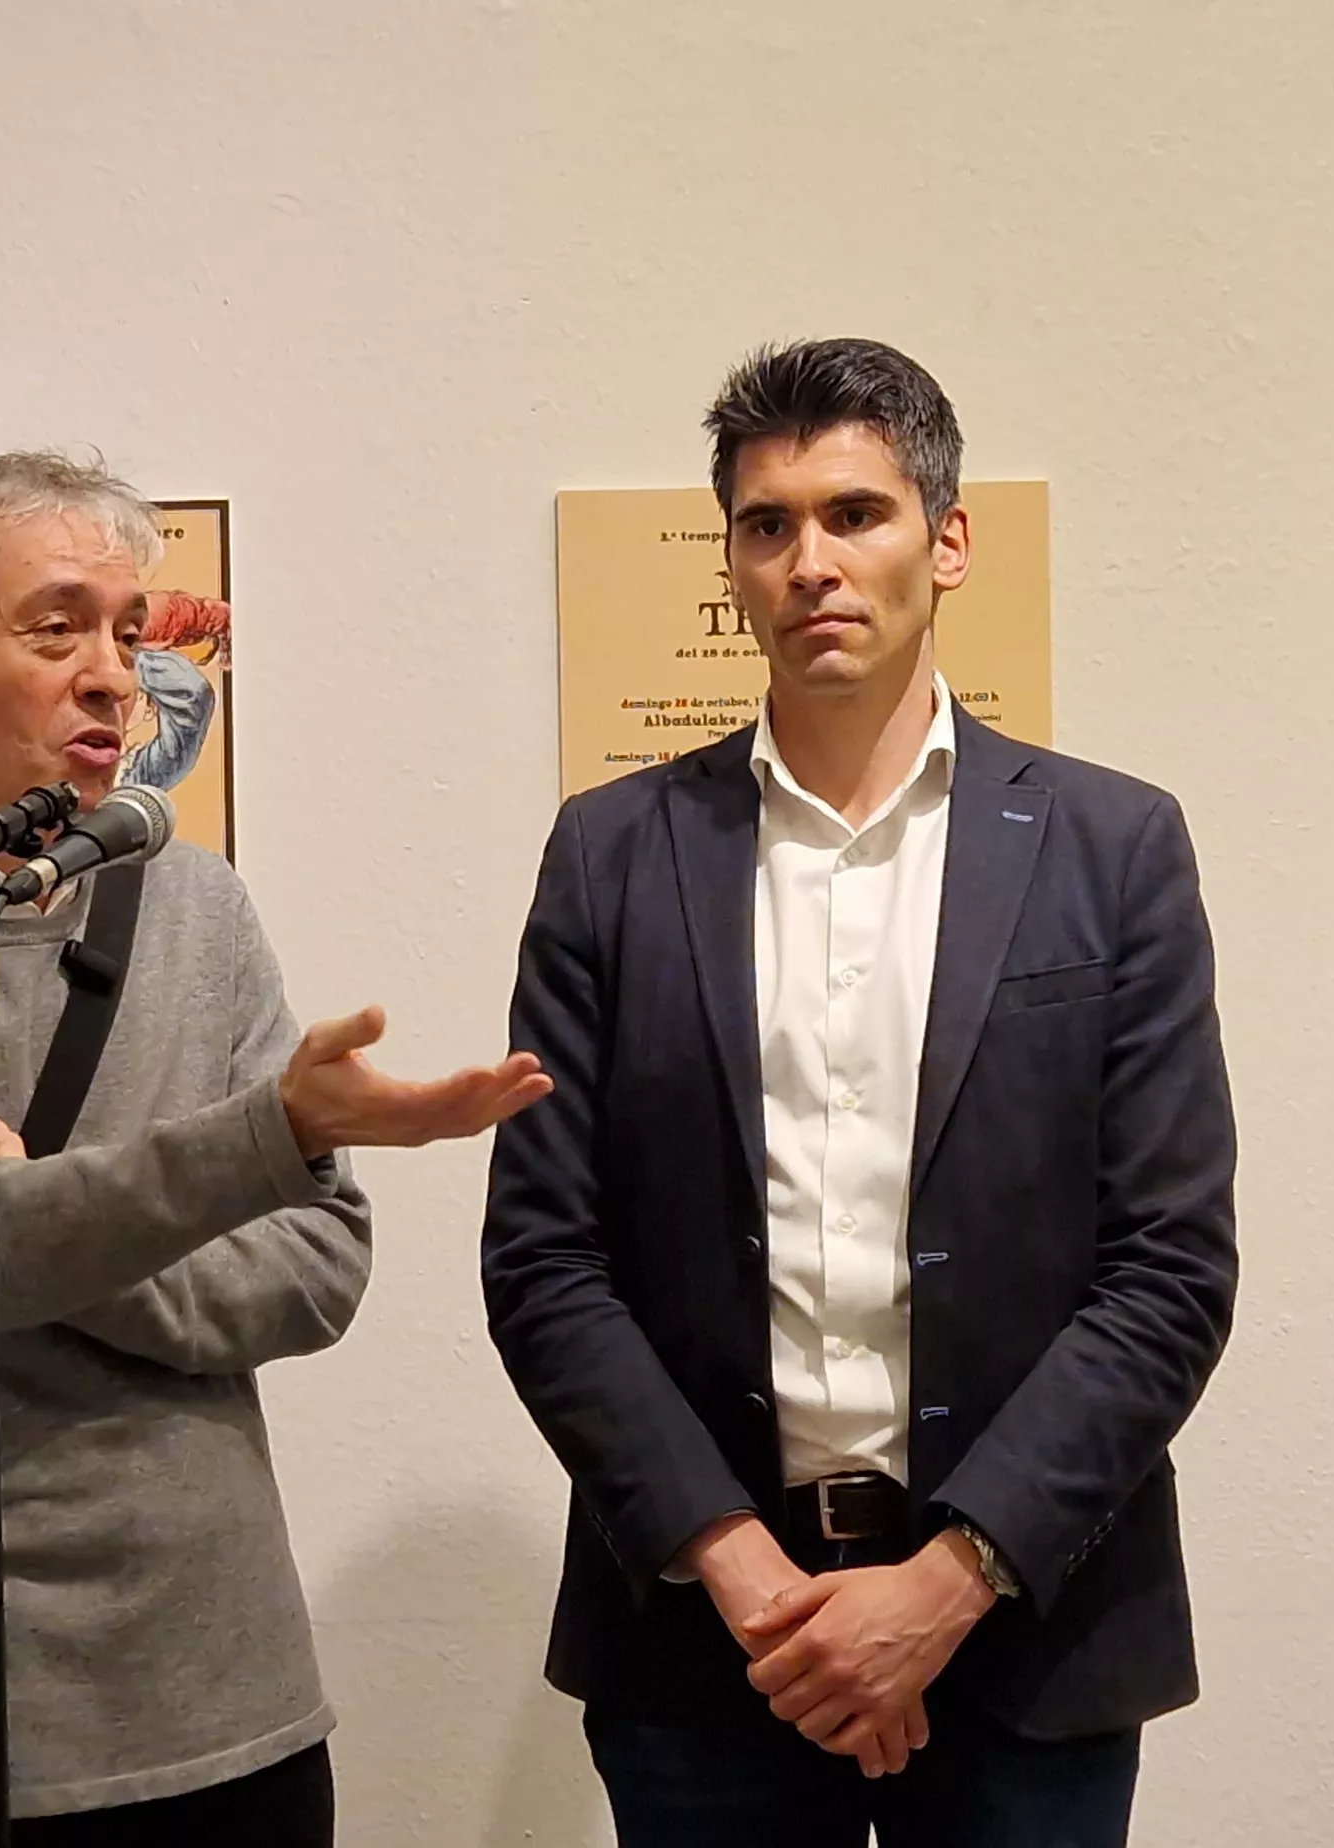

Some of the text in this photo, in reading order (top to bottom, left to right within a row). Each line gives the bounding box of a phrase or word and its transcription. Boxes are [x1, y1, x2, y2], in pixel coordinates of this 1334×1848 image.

[676, 648, 697, 657] del
[702, 649, 717, 657] 28
[723, 648, 738, 657] de
[621, 699, 672, 710] domingo
[691, 698, 704, 707] de
[644, 714, 737, 727] Albadulake
